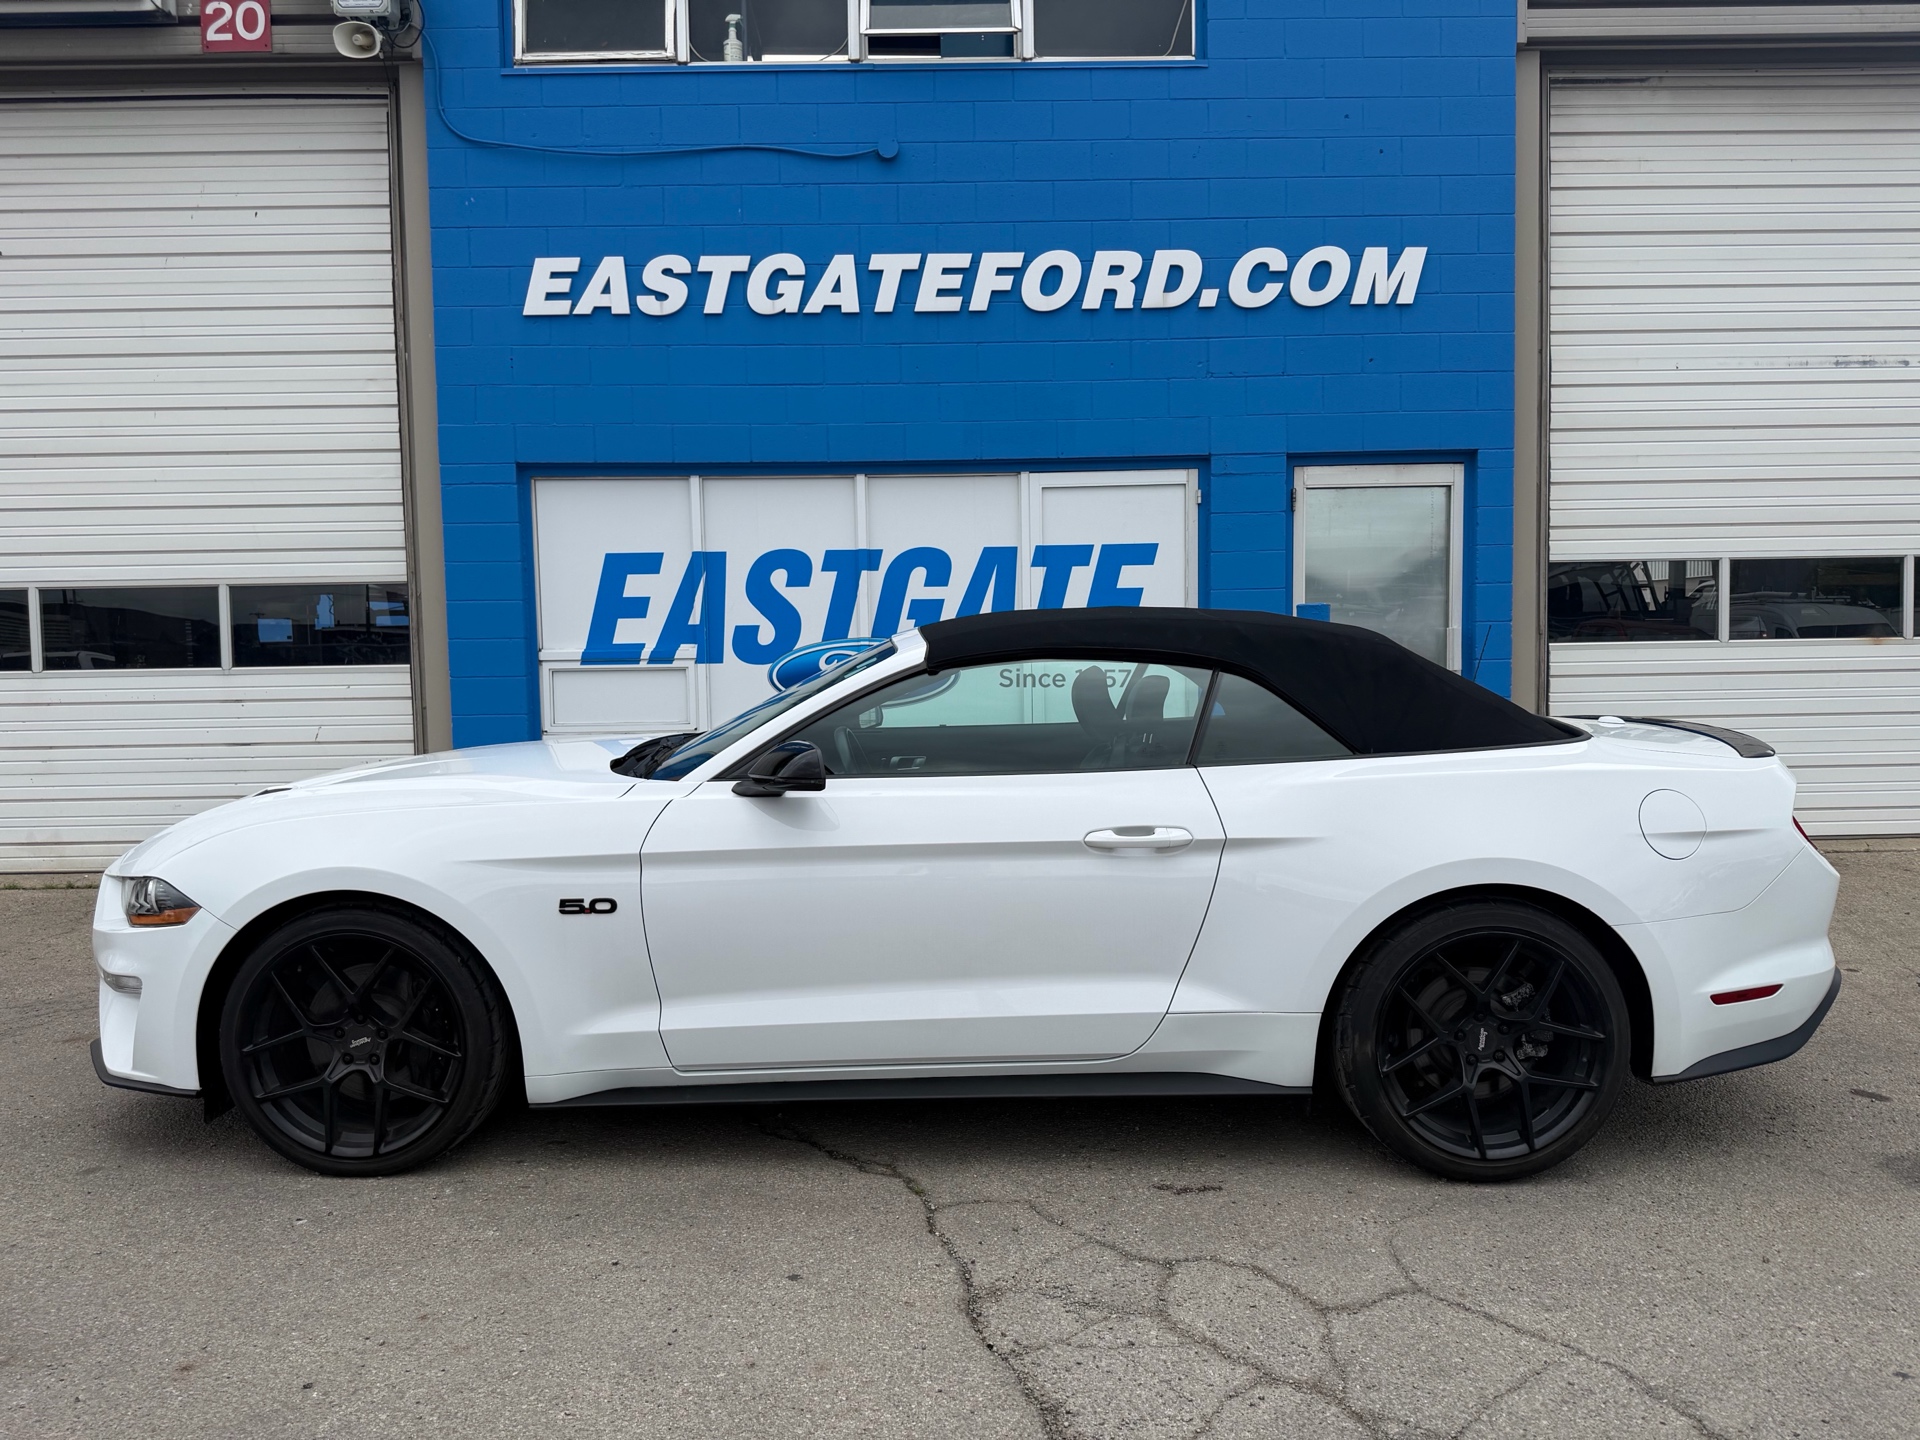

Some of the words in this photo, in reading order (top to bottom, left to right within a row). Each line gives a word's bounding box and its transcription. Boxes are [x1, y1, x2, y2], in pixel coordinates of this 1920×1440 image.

[205, 1, 266, 41] 20
[523, 246, 1427, 315] EASTGATEFORD.COM
[999, 668, 1067, 688] Since
[1074, 668, 1132, 688] 57
[558, 897, 618, 915] 5.0
